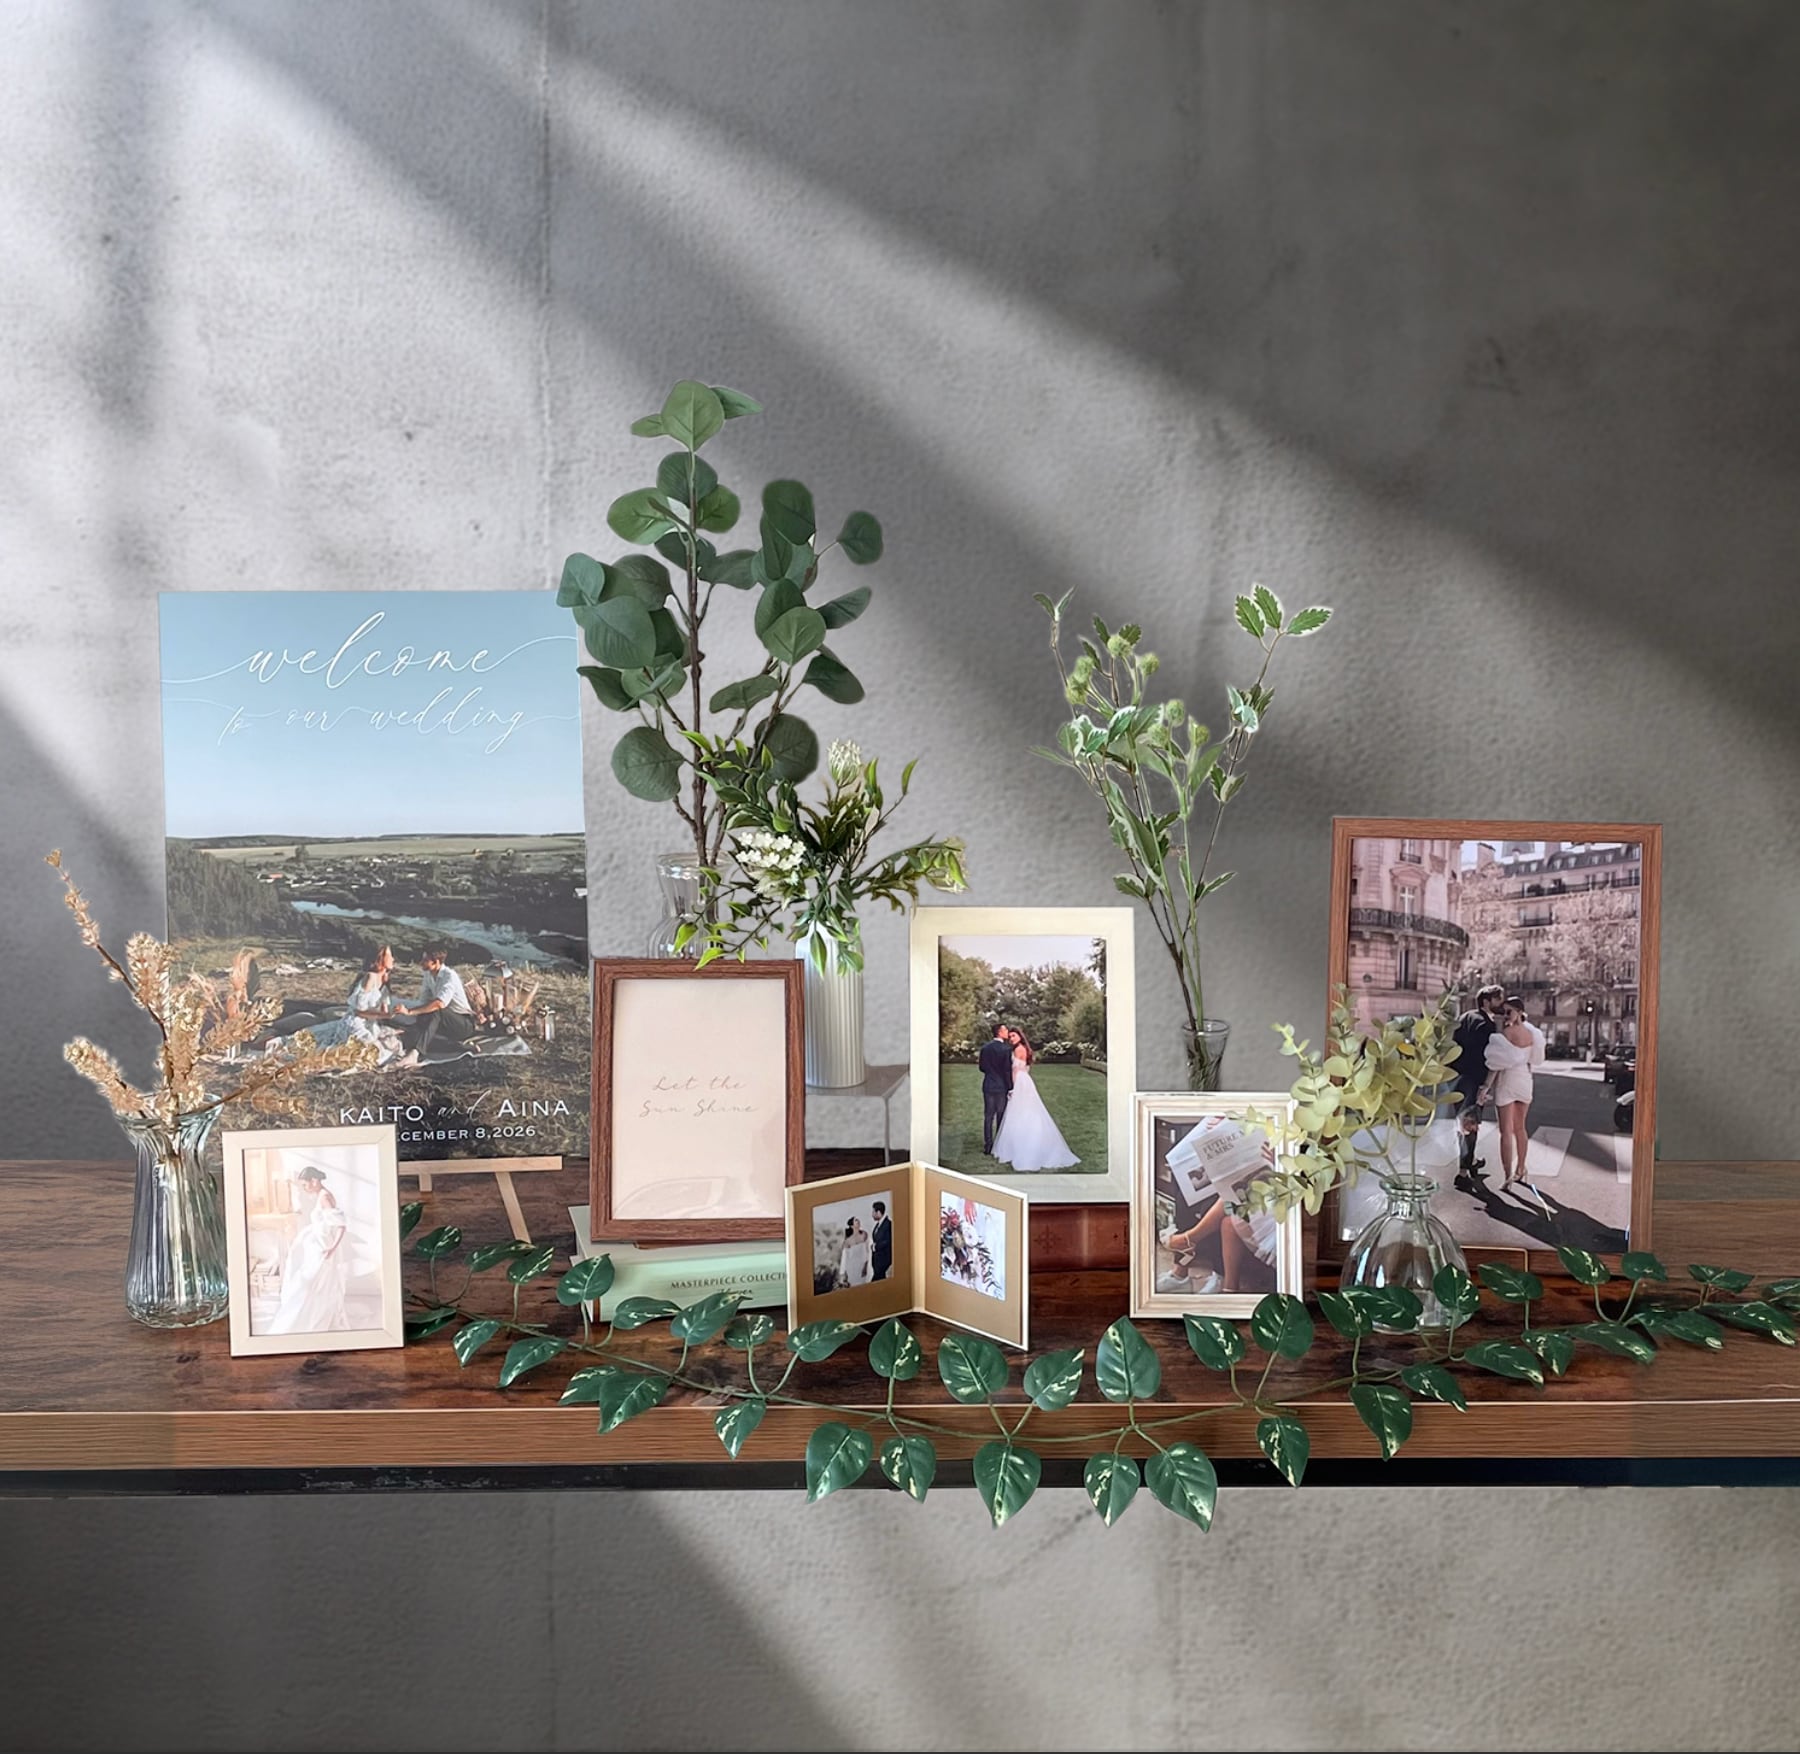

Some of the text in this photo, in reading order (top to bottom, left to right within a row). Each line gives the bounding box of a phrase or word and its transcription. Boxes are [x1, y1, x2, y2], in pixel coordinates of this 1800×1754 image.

[240, 611, 505, 689] welcome
[217, 686, 526, 755] to our wedding
[652, 1075, 748, 1092] Let the
[339, 1089, 571, 1124] KAITO and AINA
[639, 1099, 760, 1118] Sun Shine
[397, 1128, 469, 1143] CEMBER
[671, 1277, 737, 1289] MASTERPIECE
